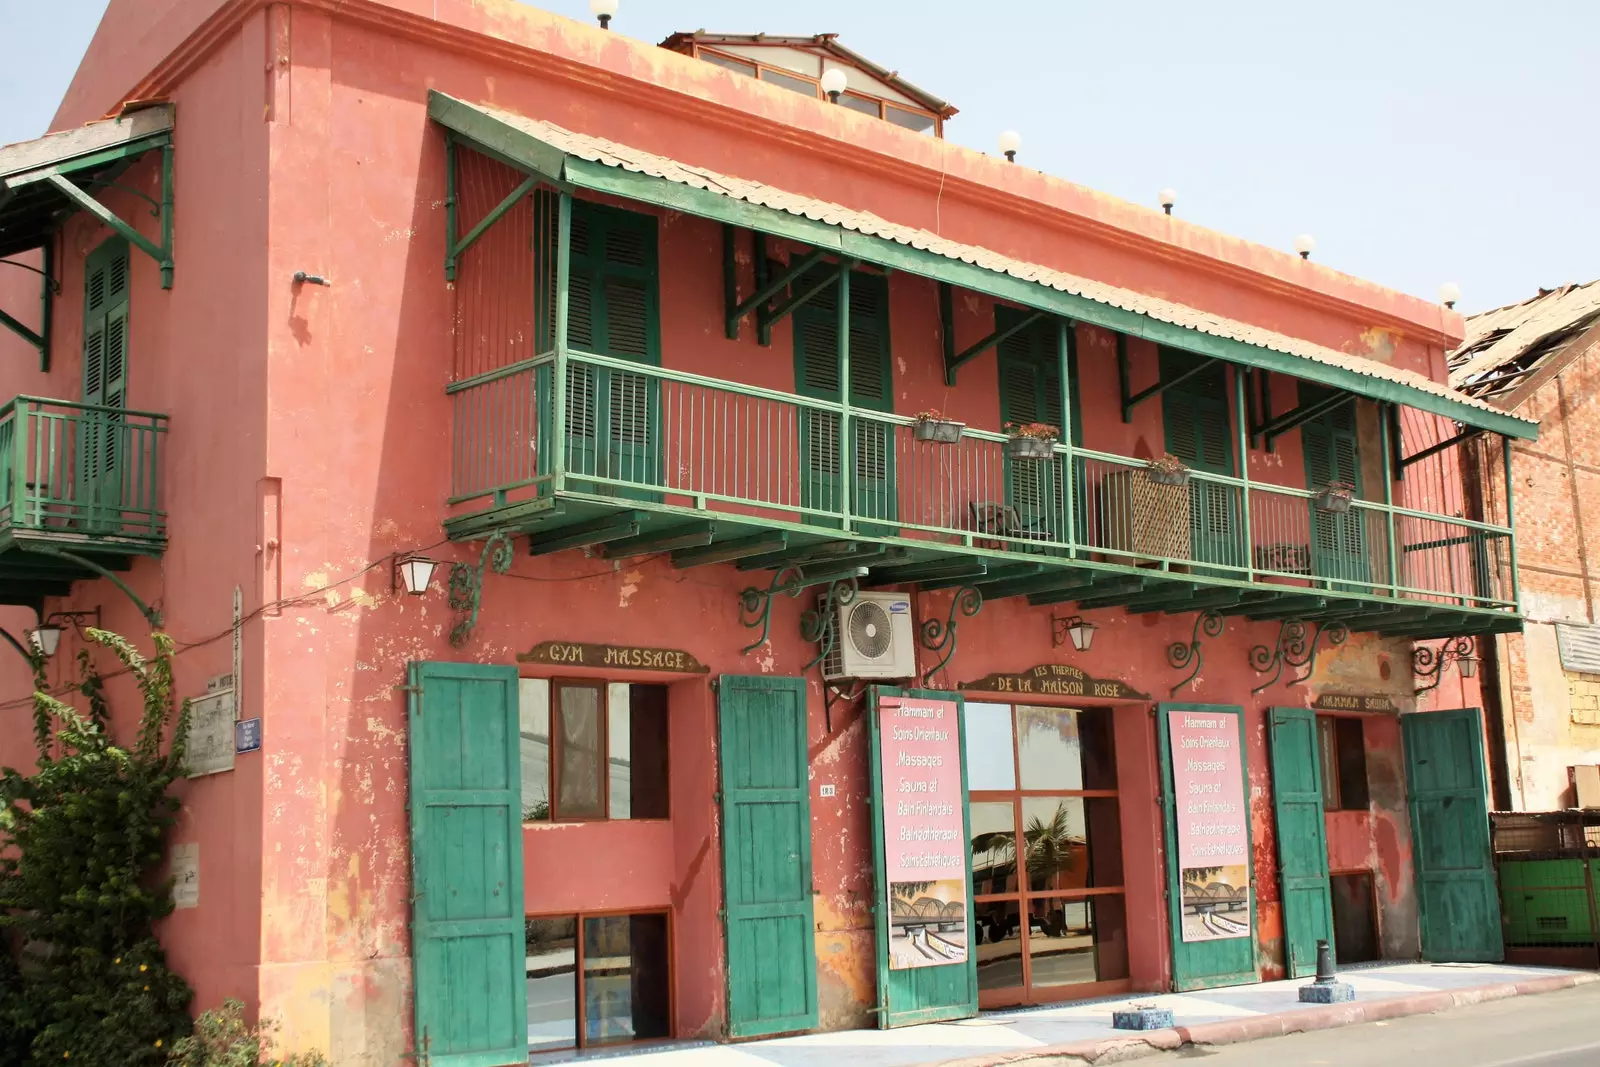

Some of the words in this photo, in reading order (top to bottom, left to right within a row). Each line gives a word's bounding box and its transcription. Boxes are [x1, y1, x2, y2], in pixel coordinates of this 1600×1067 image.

[550, 645, 583, 662] GYM
[604, 648, 684, 668] MASSAGE
[1034, 665, 1047, 677] LES
[1051, 665, 1083, 680] THERMES
[998, 677, 1012, 691] DE
[1018, 679, 1032, 692] LA
[1095, 683, 1119, 697] ROSE
[1322, 695, 1360, 709] HAMMAM
[892, 725, 914, 740] Soins
[915, 726, 949, 741] Orientaux
[1180, 735, 1198, 749] Soins
[897, 800, 915, 816] Bain
[916, 800, 953, 816] Finlandais
